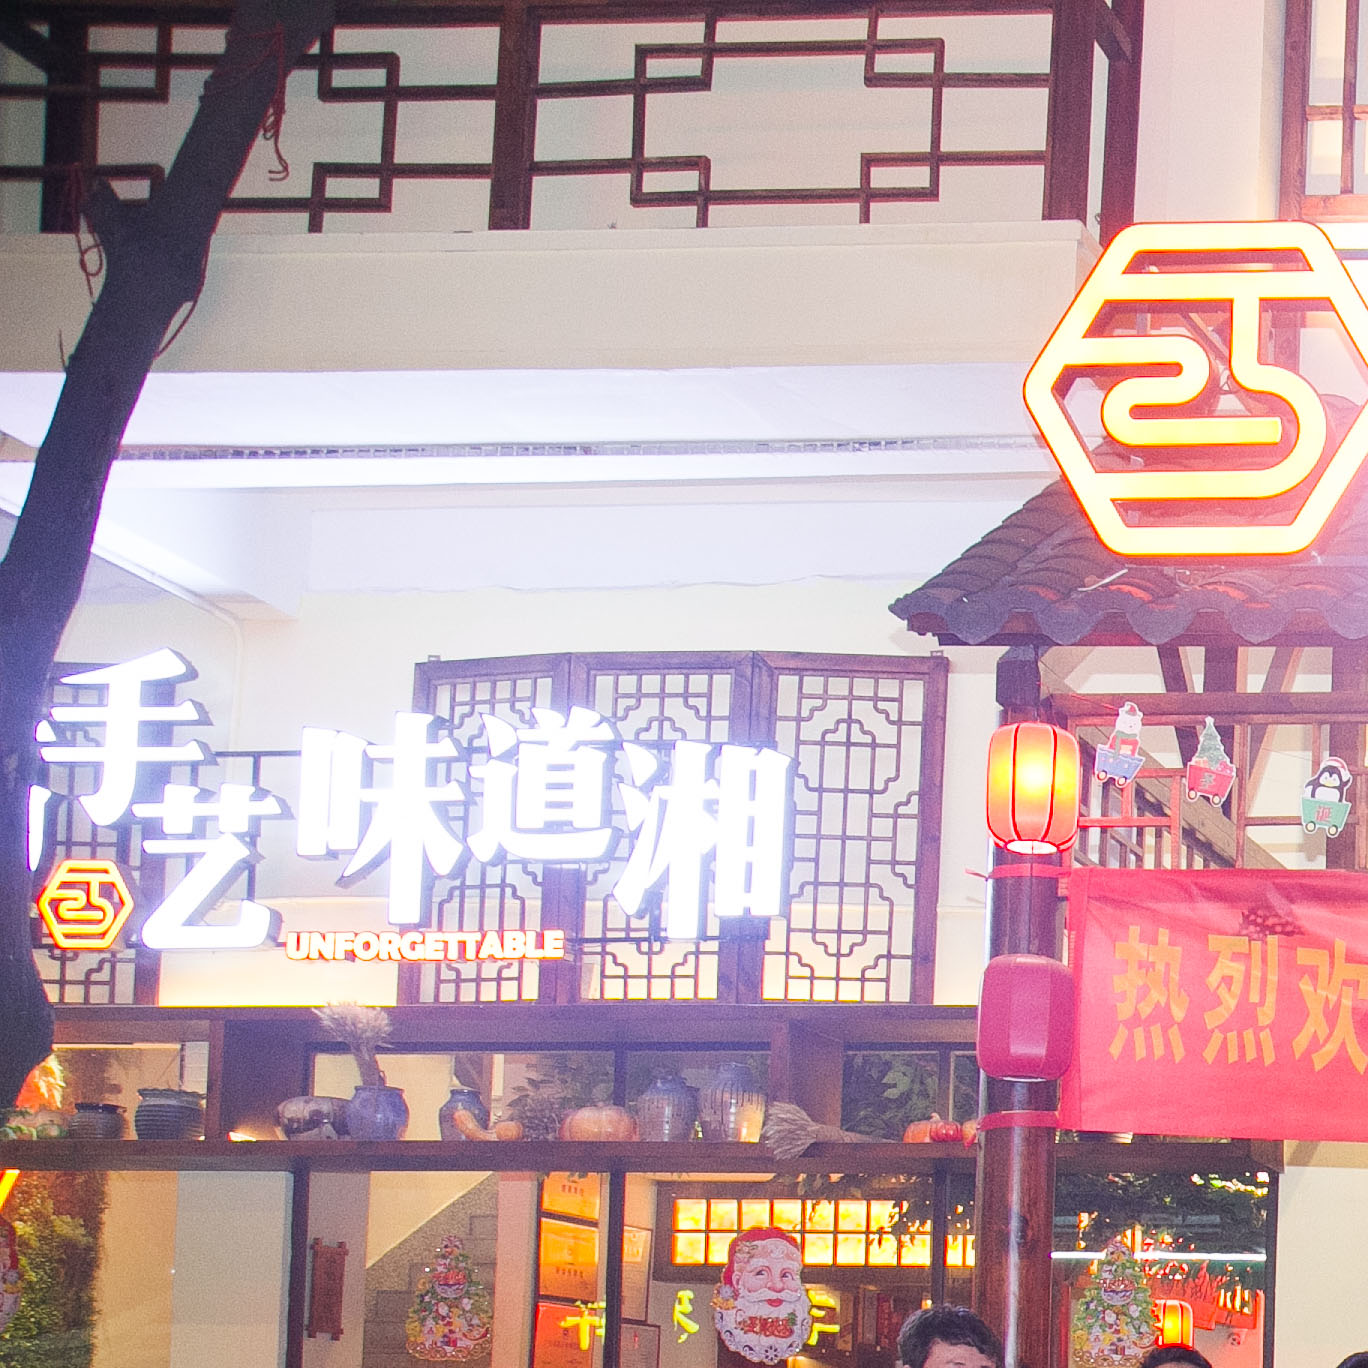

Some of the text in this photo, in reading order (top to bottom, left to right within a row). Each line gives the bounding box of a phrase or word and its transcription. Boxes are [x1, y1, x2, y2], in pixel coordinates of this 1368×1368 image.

[27, 648, 797, 950] 手艺味道湘
[285, 930, 566, 962] UNFORGETTABLE
